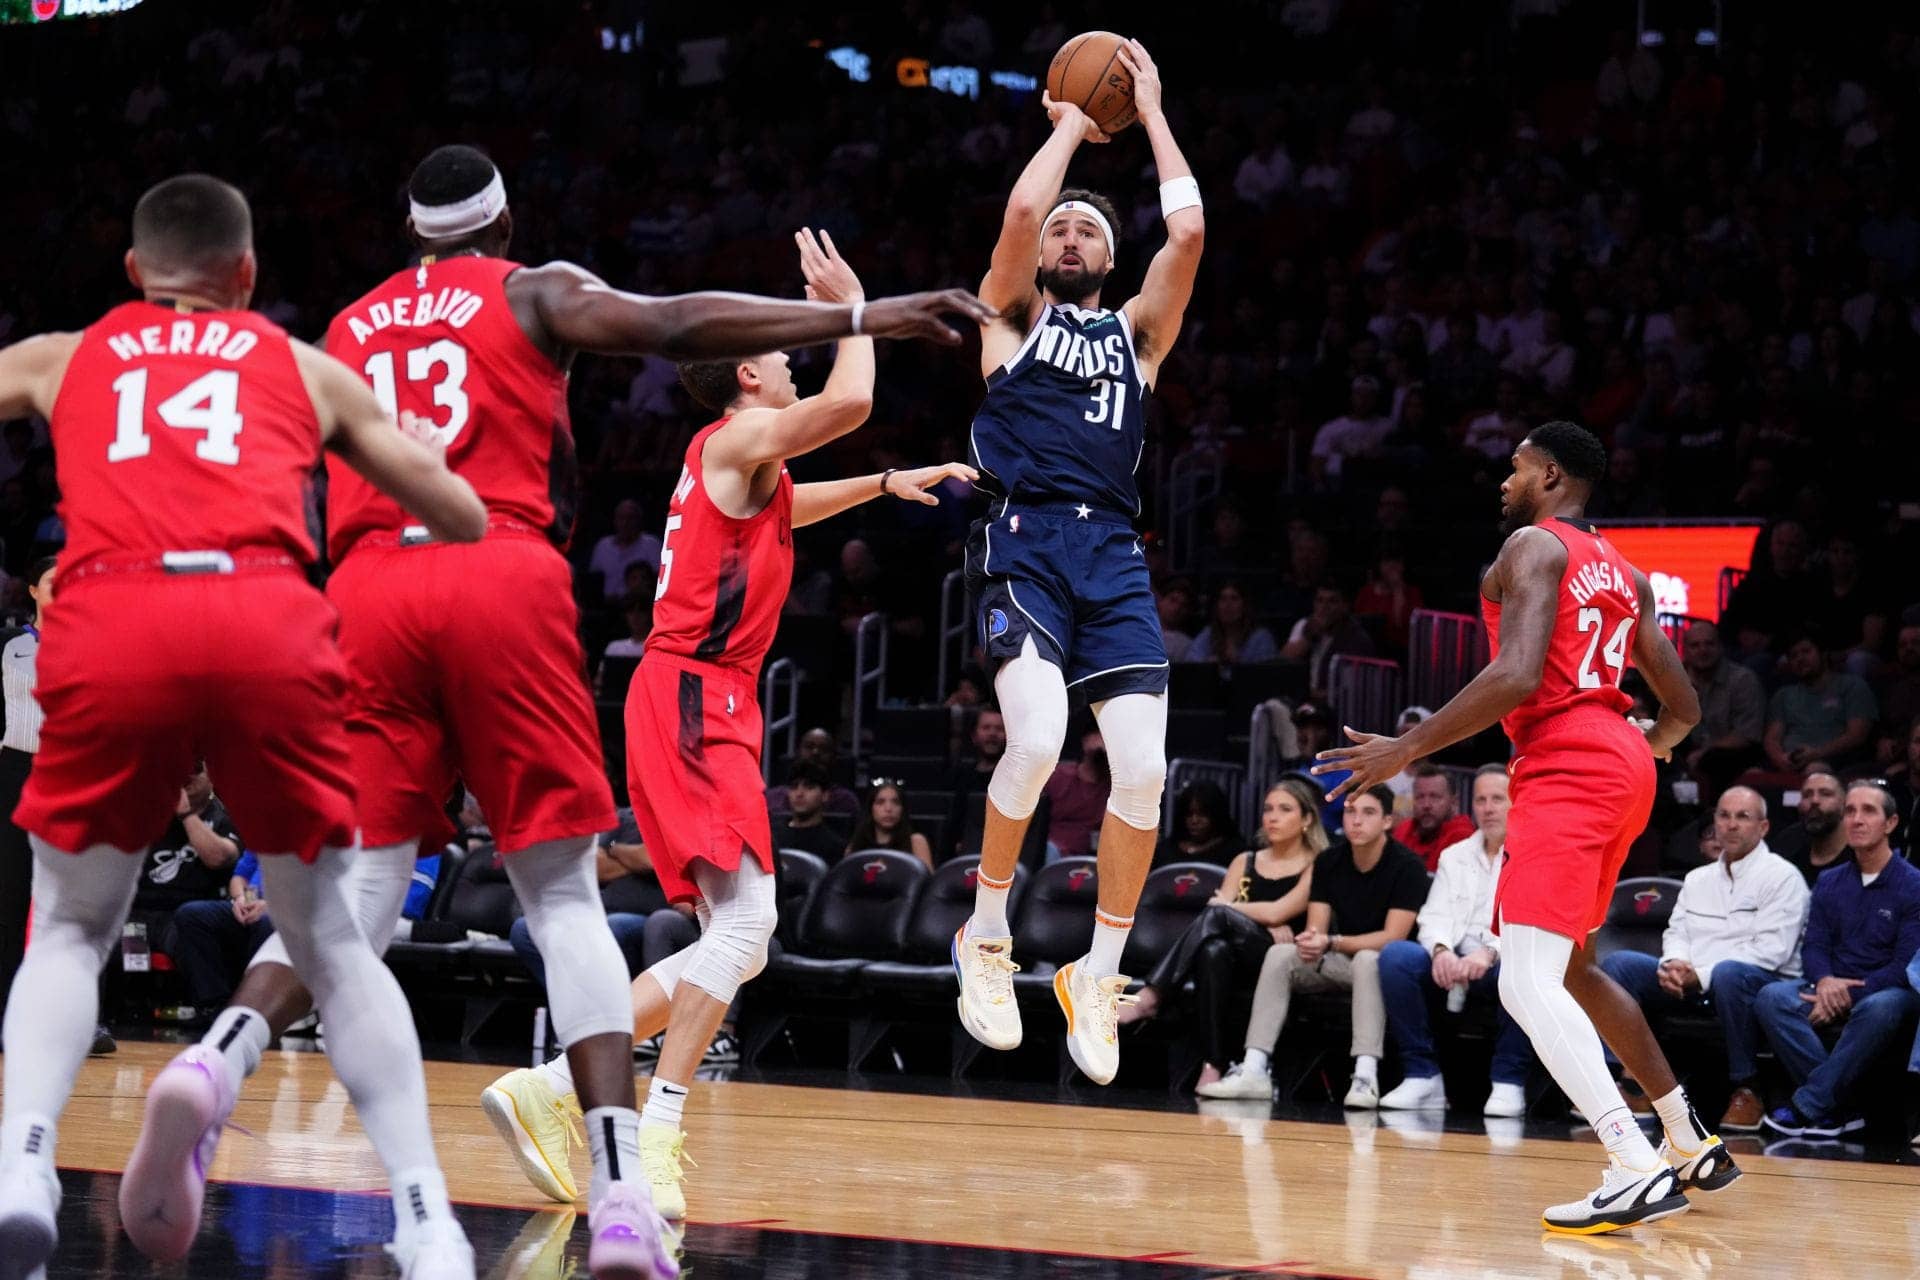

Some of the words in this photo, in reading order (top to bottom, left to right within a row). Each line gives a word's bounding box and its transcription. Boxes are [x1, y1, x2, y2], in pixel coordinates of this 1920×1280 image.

[107, 320, 258, 361] HERRO
[107, 367, 243, 465] 14
[364, 339, 469, 447] 13
[1084, 378, 1127, 431] 31
[1568, 561, 1640, 615] HIGHSM
[1577, 607, 1636, 690] 24
